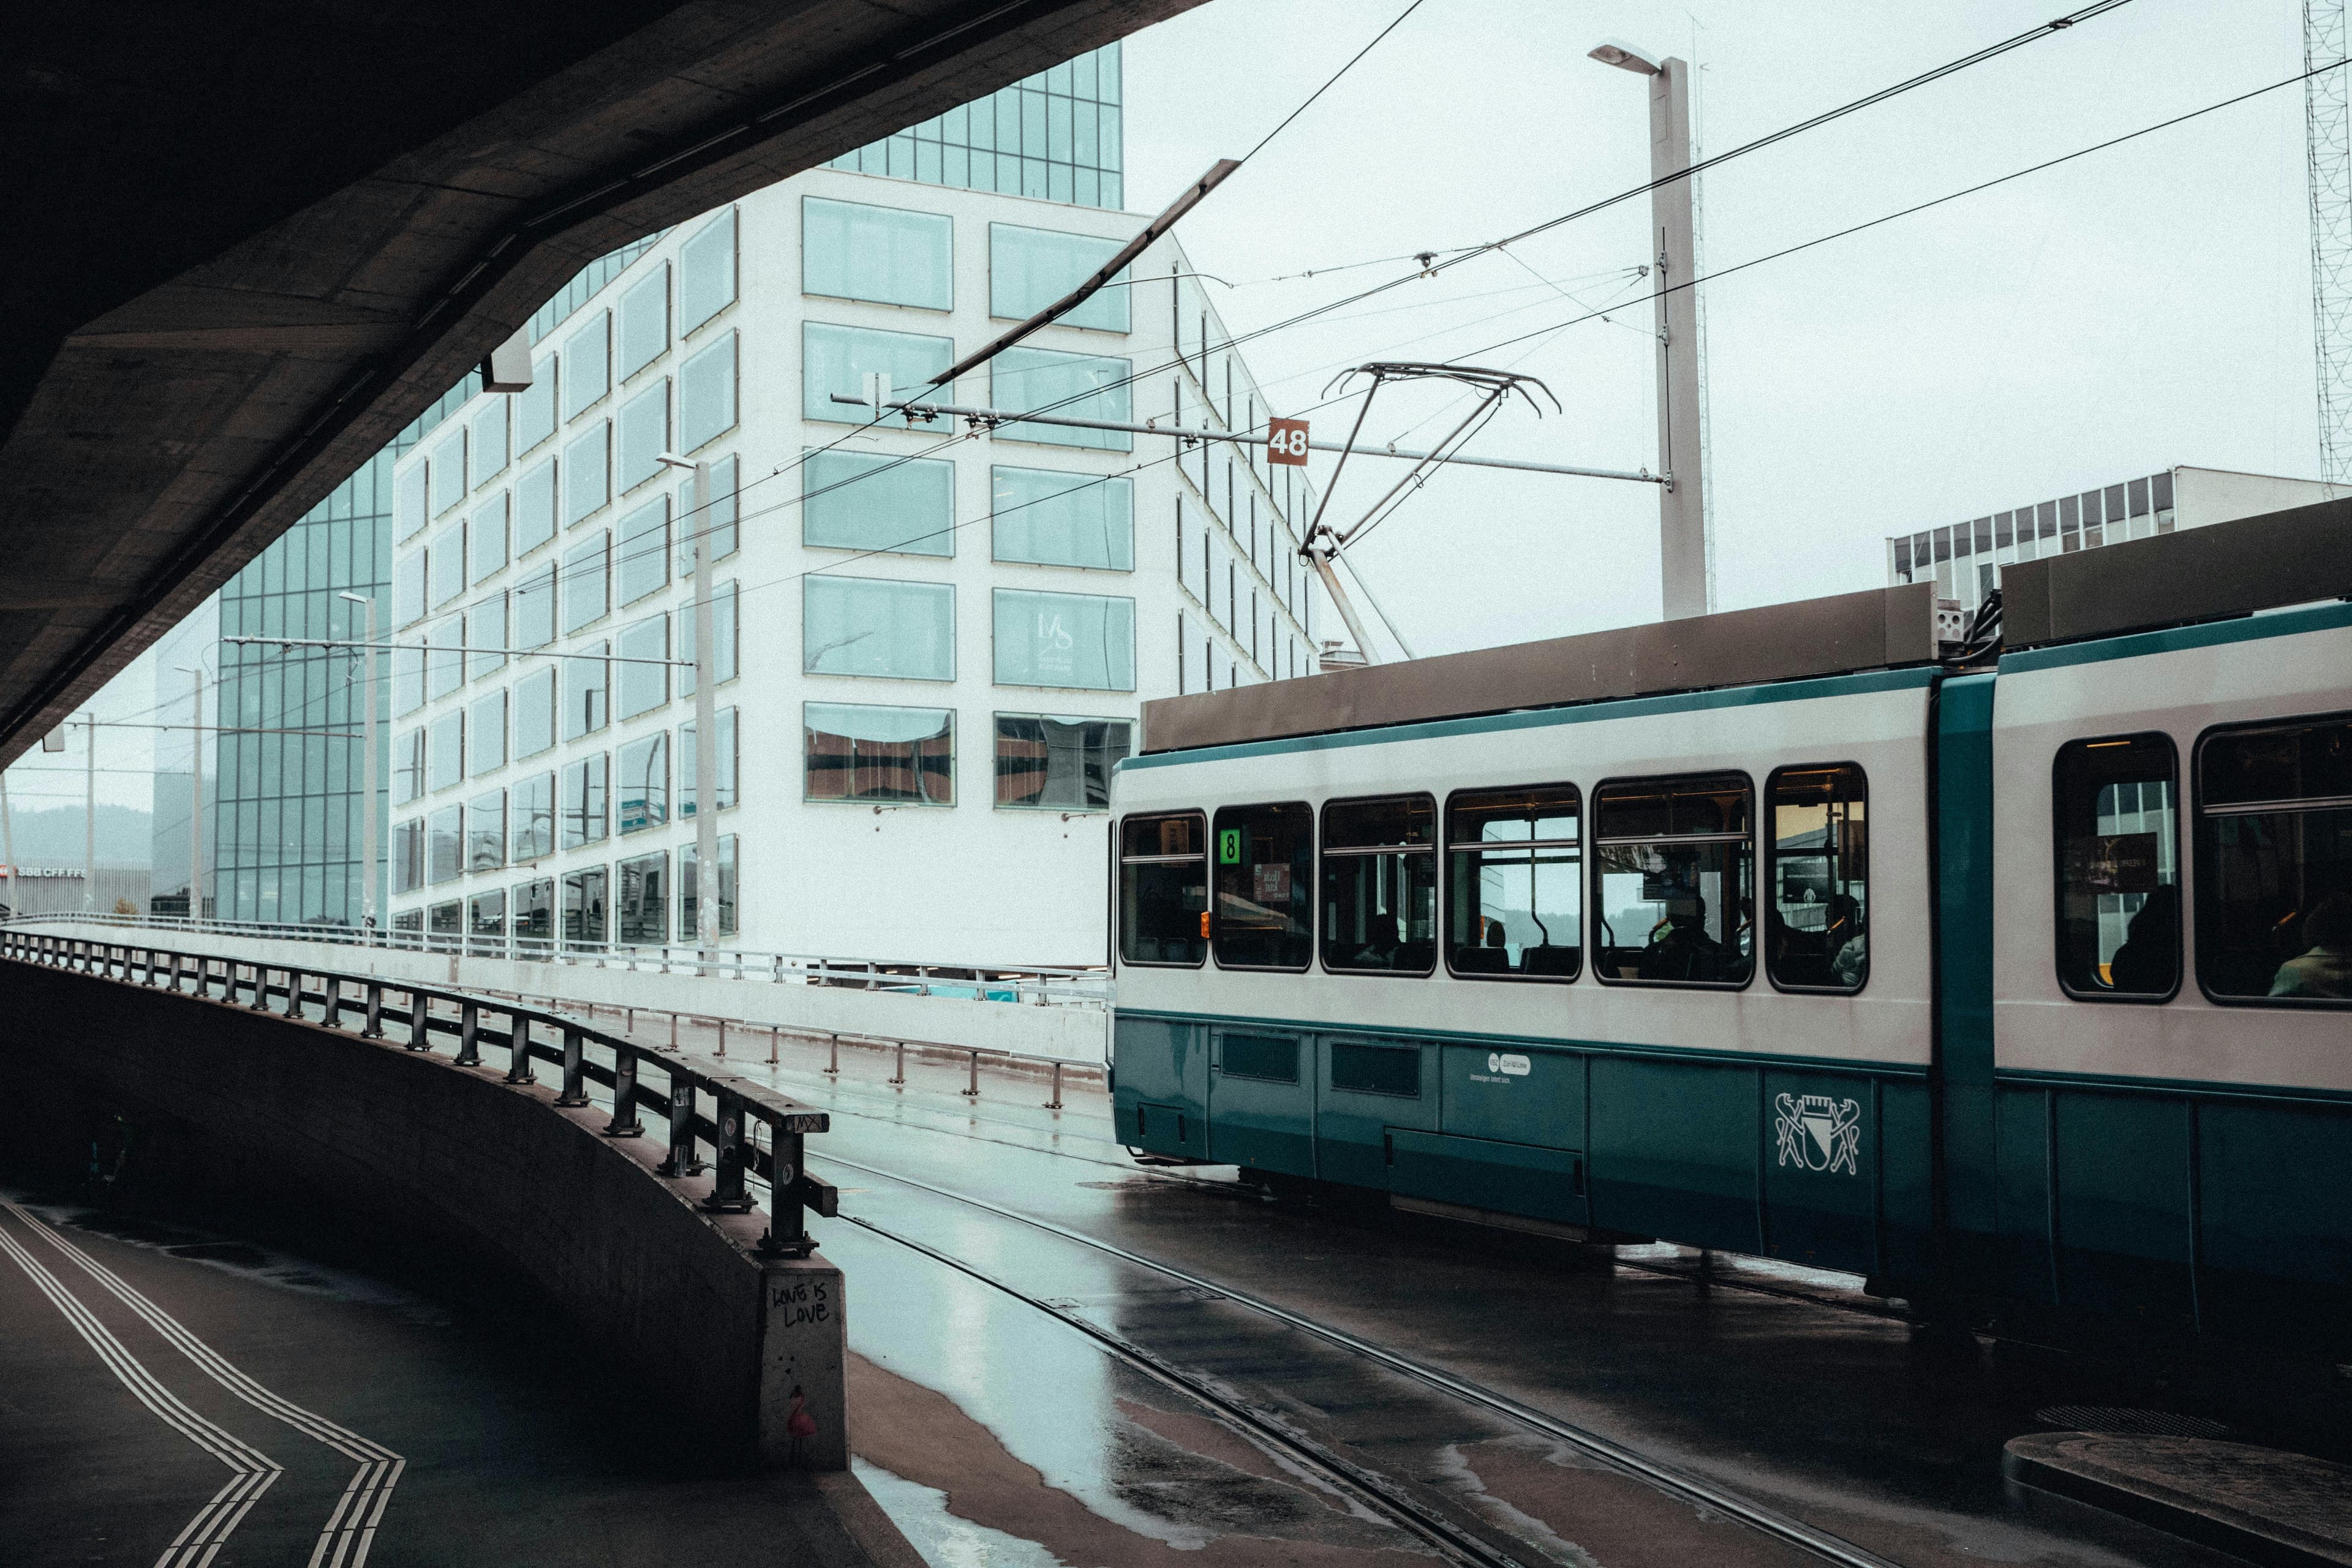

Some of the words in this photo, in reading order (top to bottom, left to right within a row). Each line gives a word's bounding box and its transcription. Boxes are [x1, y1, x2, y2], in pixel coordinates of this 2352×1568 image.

[1270, 428, 1307, 456] 48
[1226, 833, 1235, 859] 8
[18, 866, 42, 876] SBB
[43, 867, 64, 877] CFF
[67, 868, 88, 878] FFS
[772, 1283, 807, 1308] LOVE
[813, 1282, 827, 1301] IS
[784, 1303, 830, 1328] LOVE
